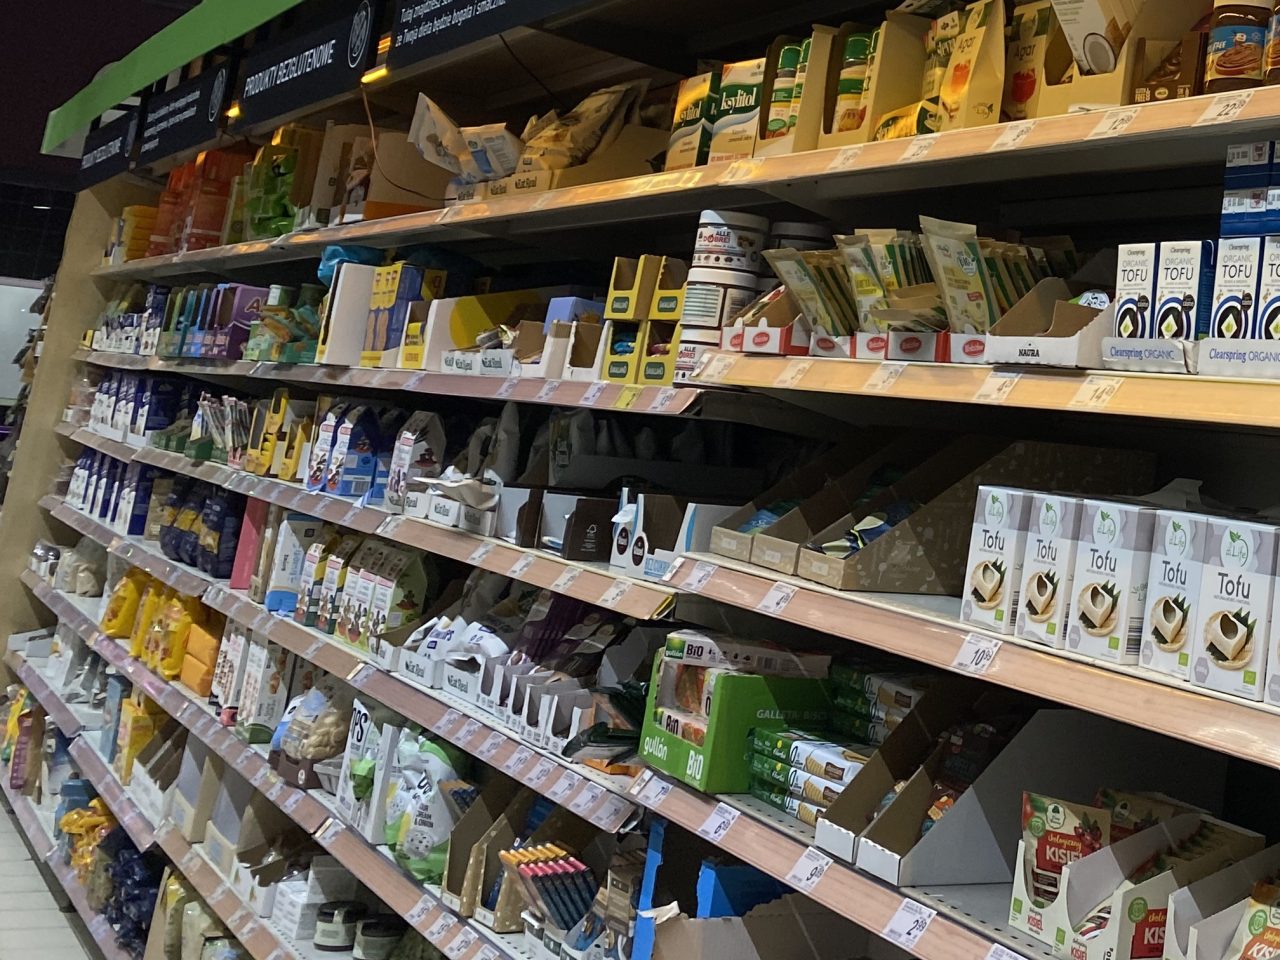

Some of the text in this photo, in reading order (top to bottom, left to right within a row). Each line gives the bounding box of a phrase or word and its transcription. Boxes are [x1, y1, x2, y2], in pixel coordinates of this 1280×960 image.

[957, 34, 976, 52] Agar
[1014, 42, 1036, 61] Agar
[277, 40, 336, 85] BEZGLUTENOWE
[720, 87, 757, 114] ksylitol
[1122, 257, 1148, 268] ORGANIC
[1164, 256, 1194, 267] ORGANIC
[1223, 254, 1252, 264] ORGANIC
[1121, 269, 1148, 283] TOFU
[1164, 268, 1194, 281] TOFU
[1222, 264, 1252, 279] TOFU
[1110, 347, 1175, 361] Clearspring ORGANIC
[1209, 348, 1246, 363] Clearspring
[982, 529, 1005, 551] Tofu
[1037, 539, 1057, 561] Tofu
[1090, 548, 1117, 572] Tofu
[1162, 560, 1187, 585] Tofu
[1218, 572, 1250, 599] Tofu
[644, 737, 668, 760] gullón
[1046, 845, 1087, 864] KISIE
